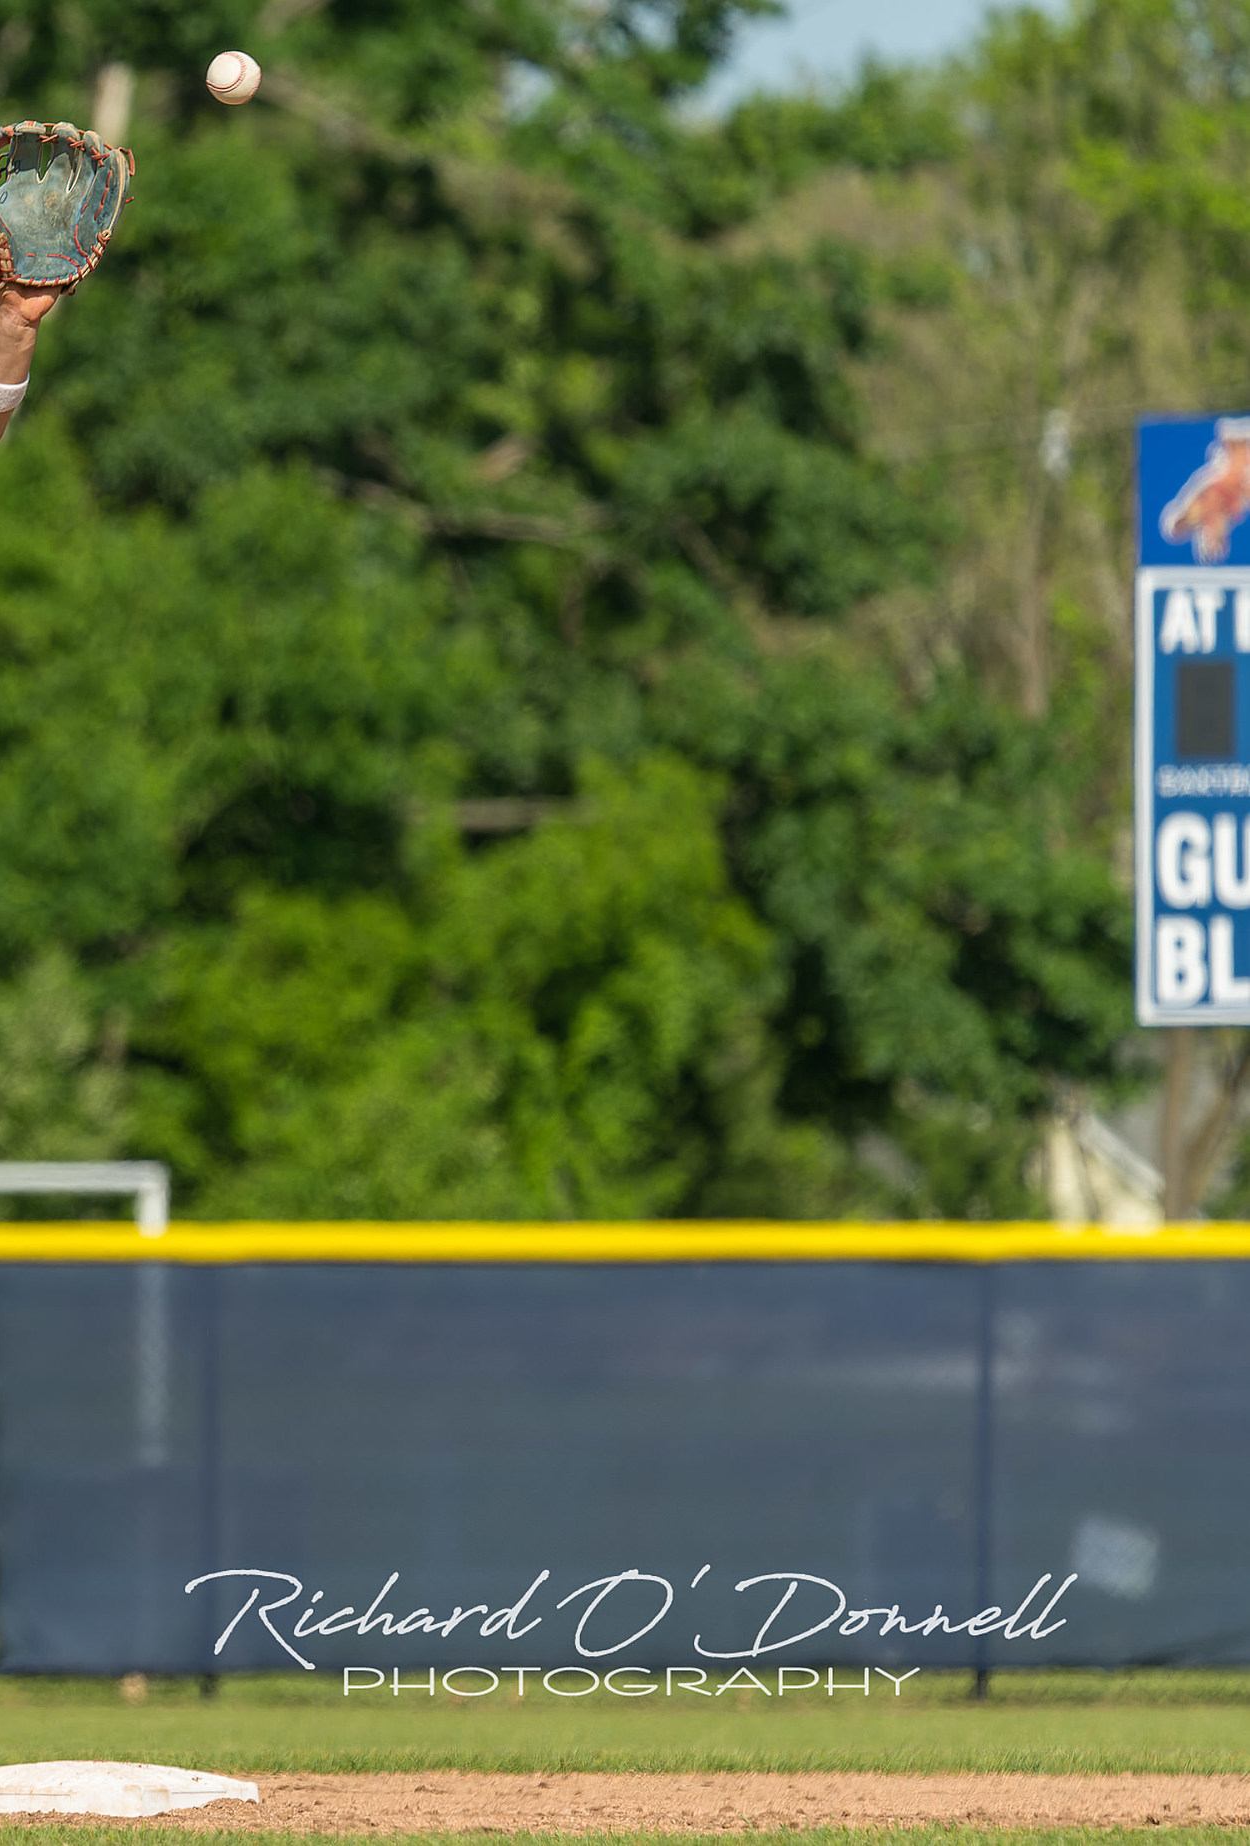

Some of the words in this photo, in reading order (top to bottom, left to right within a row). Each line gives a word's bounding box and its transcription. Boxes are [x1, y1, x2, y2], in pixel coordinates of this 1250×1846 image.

[1160, 590, 1225, 653] AT
[1155, 812, 1250, 909] GU
[1154, 914, 1250, 1007] BL
